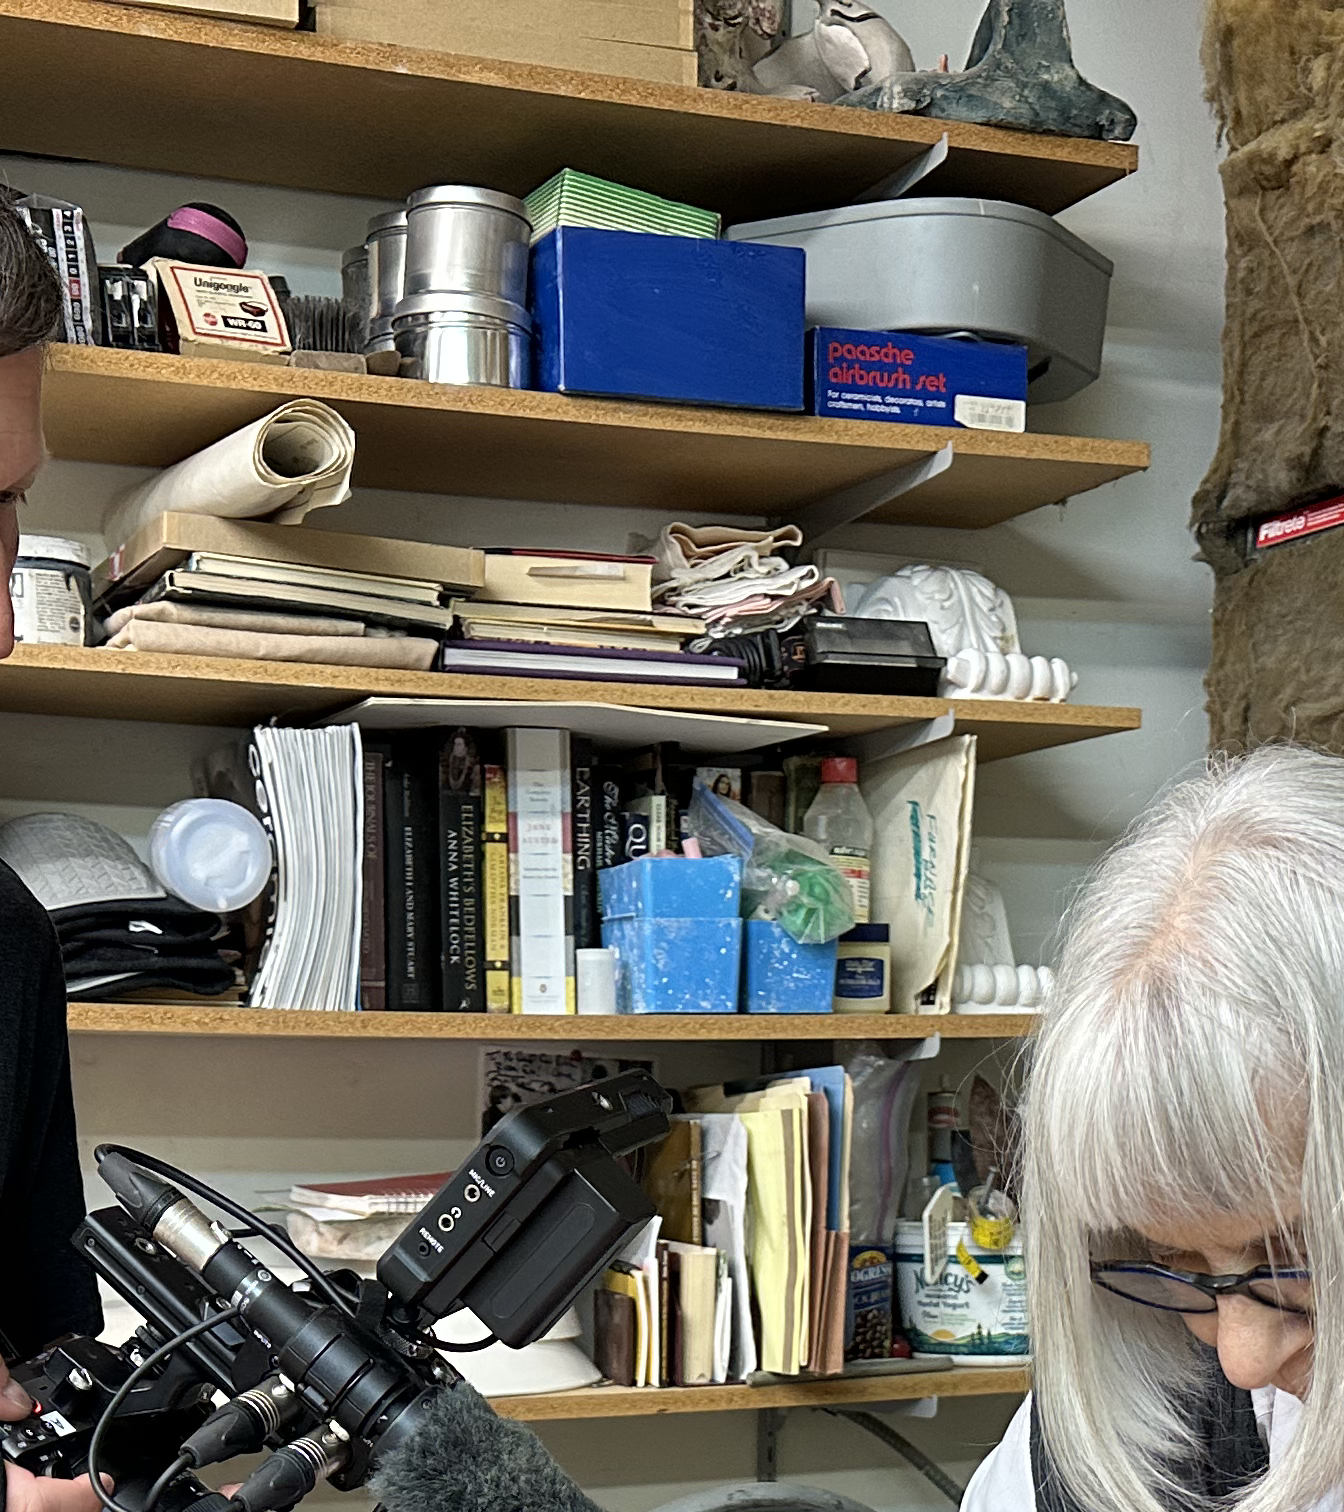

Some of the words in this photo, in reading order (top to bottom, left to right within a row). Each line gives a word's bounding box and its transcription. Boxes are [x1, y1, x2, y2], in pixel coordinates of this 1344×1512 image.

[193, 277, 250, 293] Unigoggle
[828, 341, 914, 365] paasche
[828, 362, 911, 389] airbrush
[915, 373, 947, 392] set
[576, 767, 591, 870] EARTHING
[404, 826, 413, 880] ELIZABETH
[447, 829, 458, 871] ANNA
[461, 804, 474, 894] ELIZABETH'S
[405, 888, 414, 910] AND
[406, 911, 415, 939] MARY
[448, 877, 460, 964] WHITELOCK
[407, 941, 416, 979] STUART
[463, 897, 477, 990] BEDFELLOWS
